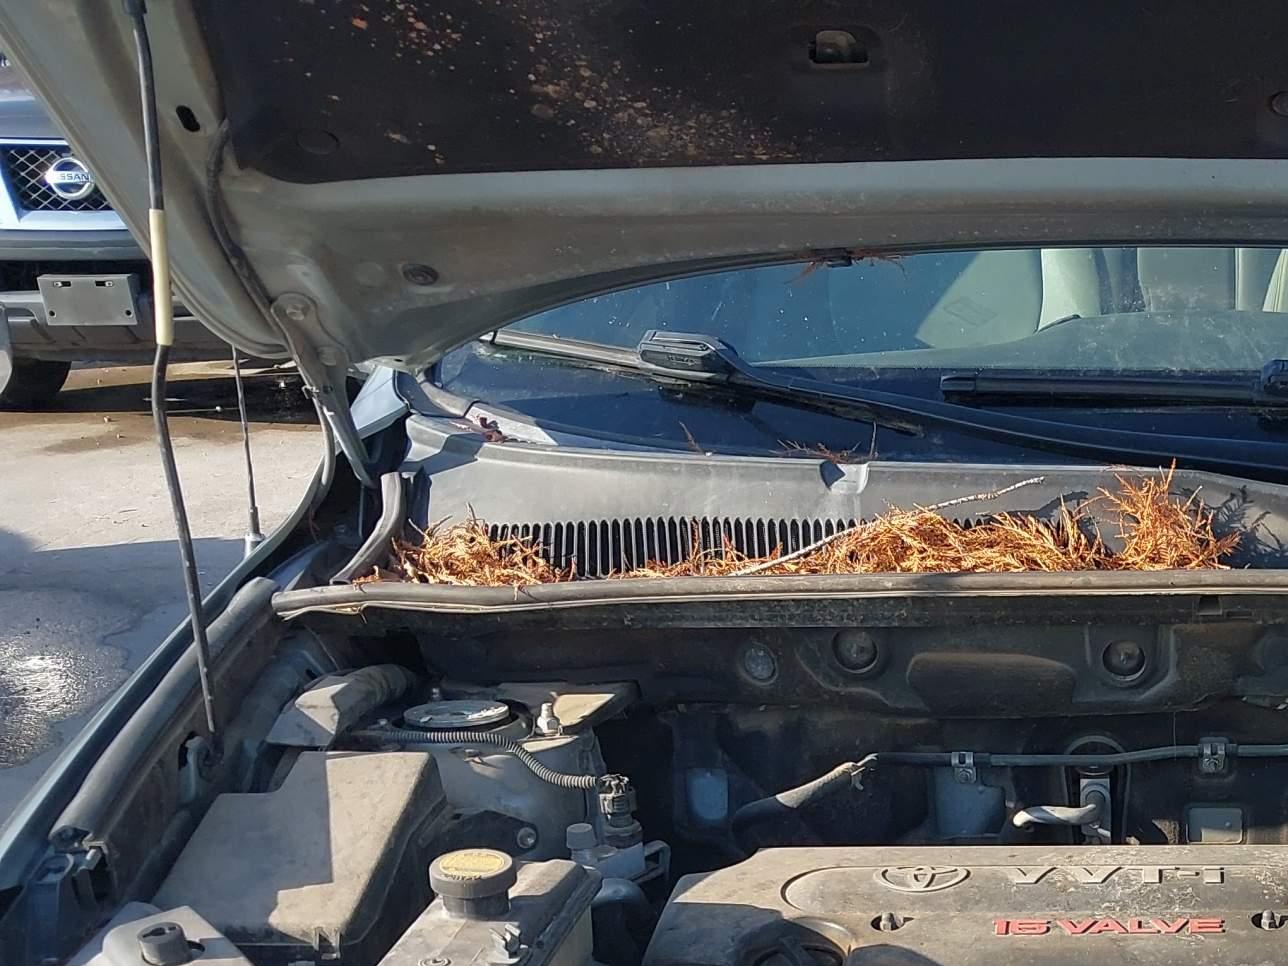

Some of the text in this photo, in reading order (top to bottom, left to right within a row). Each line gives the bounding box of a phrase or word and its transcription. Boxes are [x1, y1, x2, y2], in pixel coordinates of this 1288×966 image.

[50, 173, 90, 181] SSAN
[1004, 866, 1225, 885] VVT-i
[992, 918, 1226, 936] 16 VALVE
